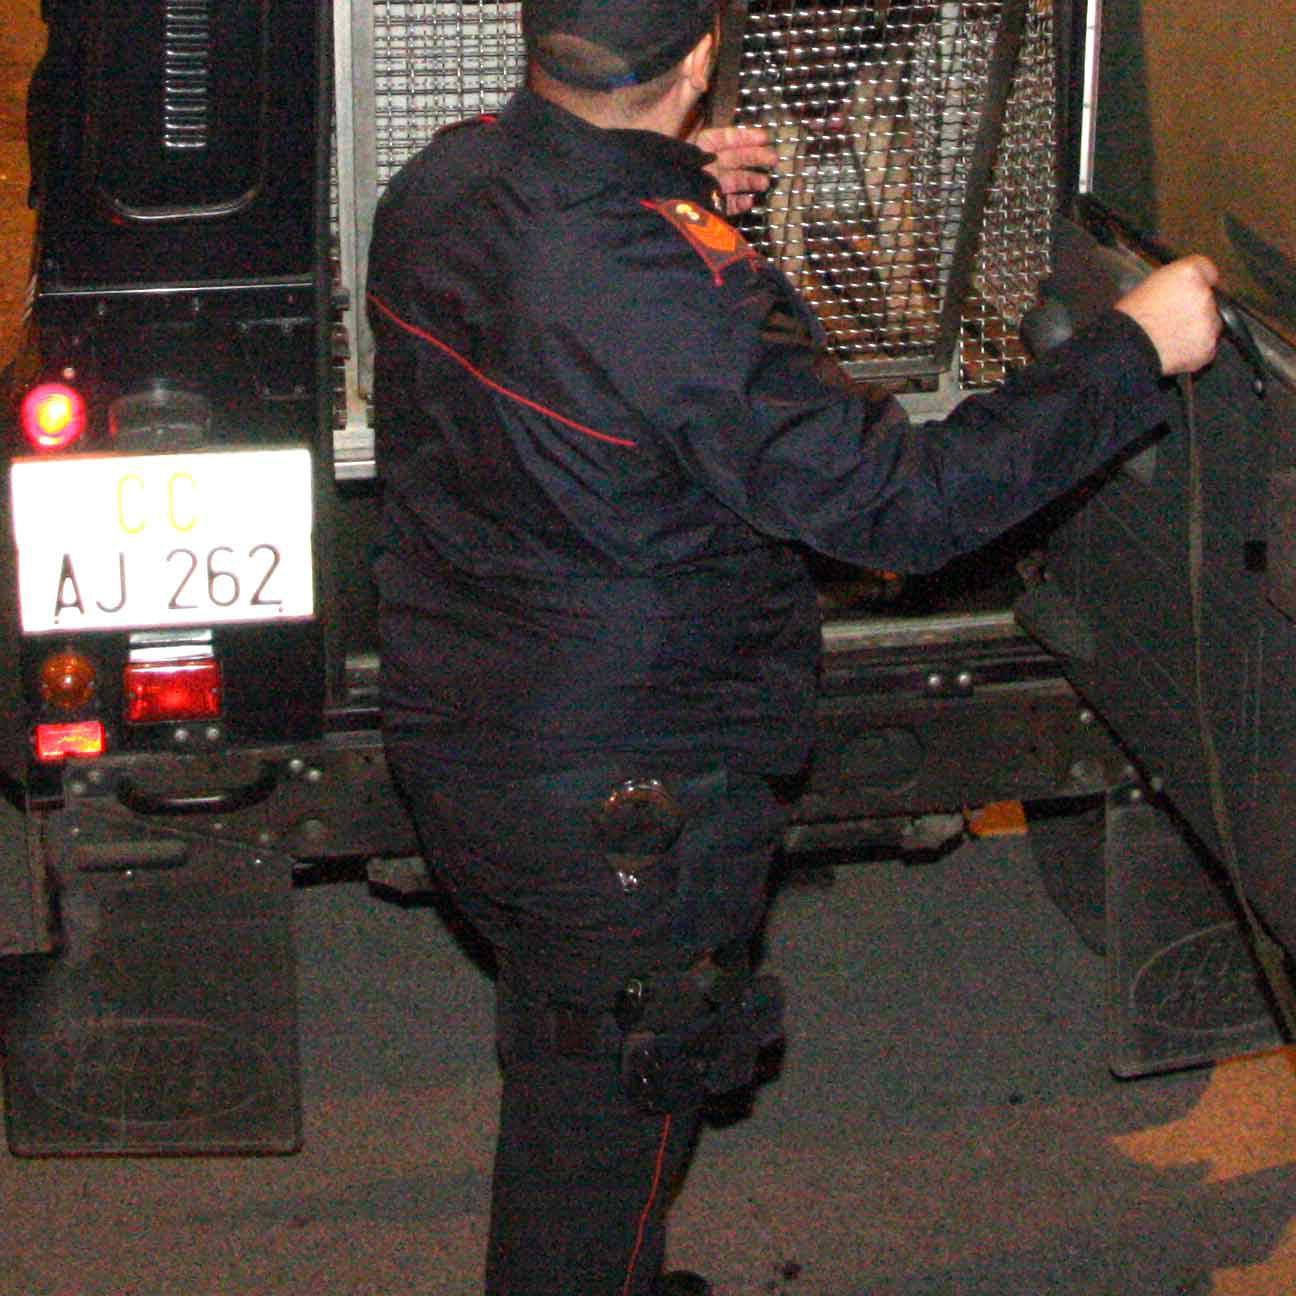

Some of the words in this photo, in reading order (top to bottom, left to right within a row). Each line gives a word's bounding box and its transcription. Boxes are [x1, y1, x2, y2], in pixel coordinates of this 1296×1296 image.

[116, 472, 199, 535] CC
[54, 551, 128, 617] AJ
[165, 544, 283, 611] 262
